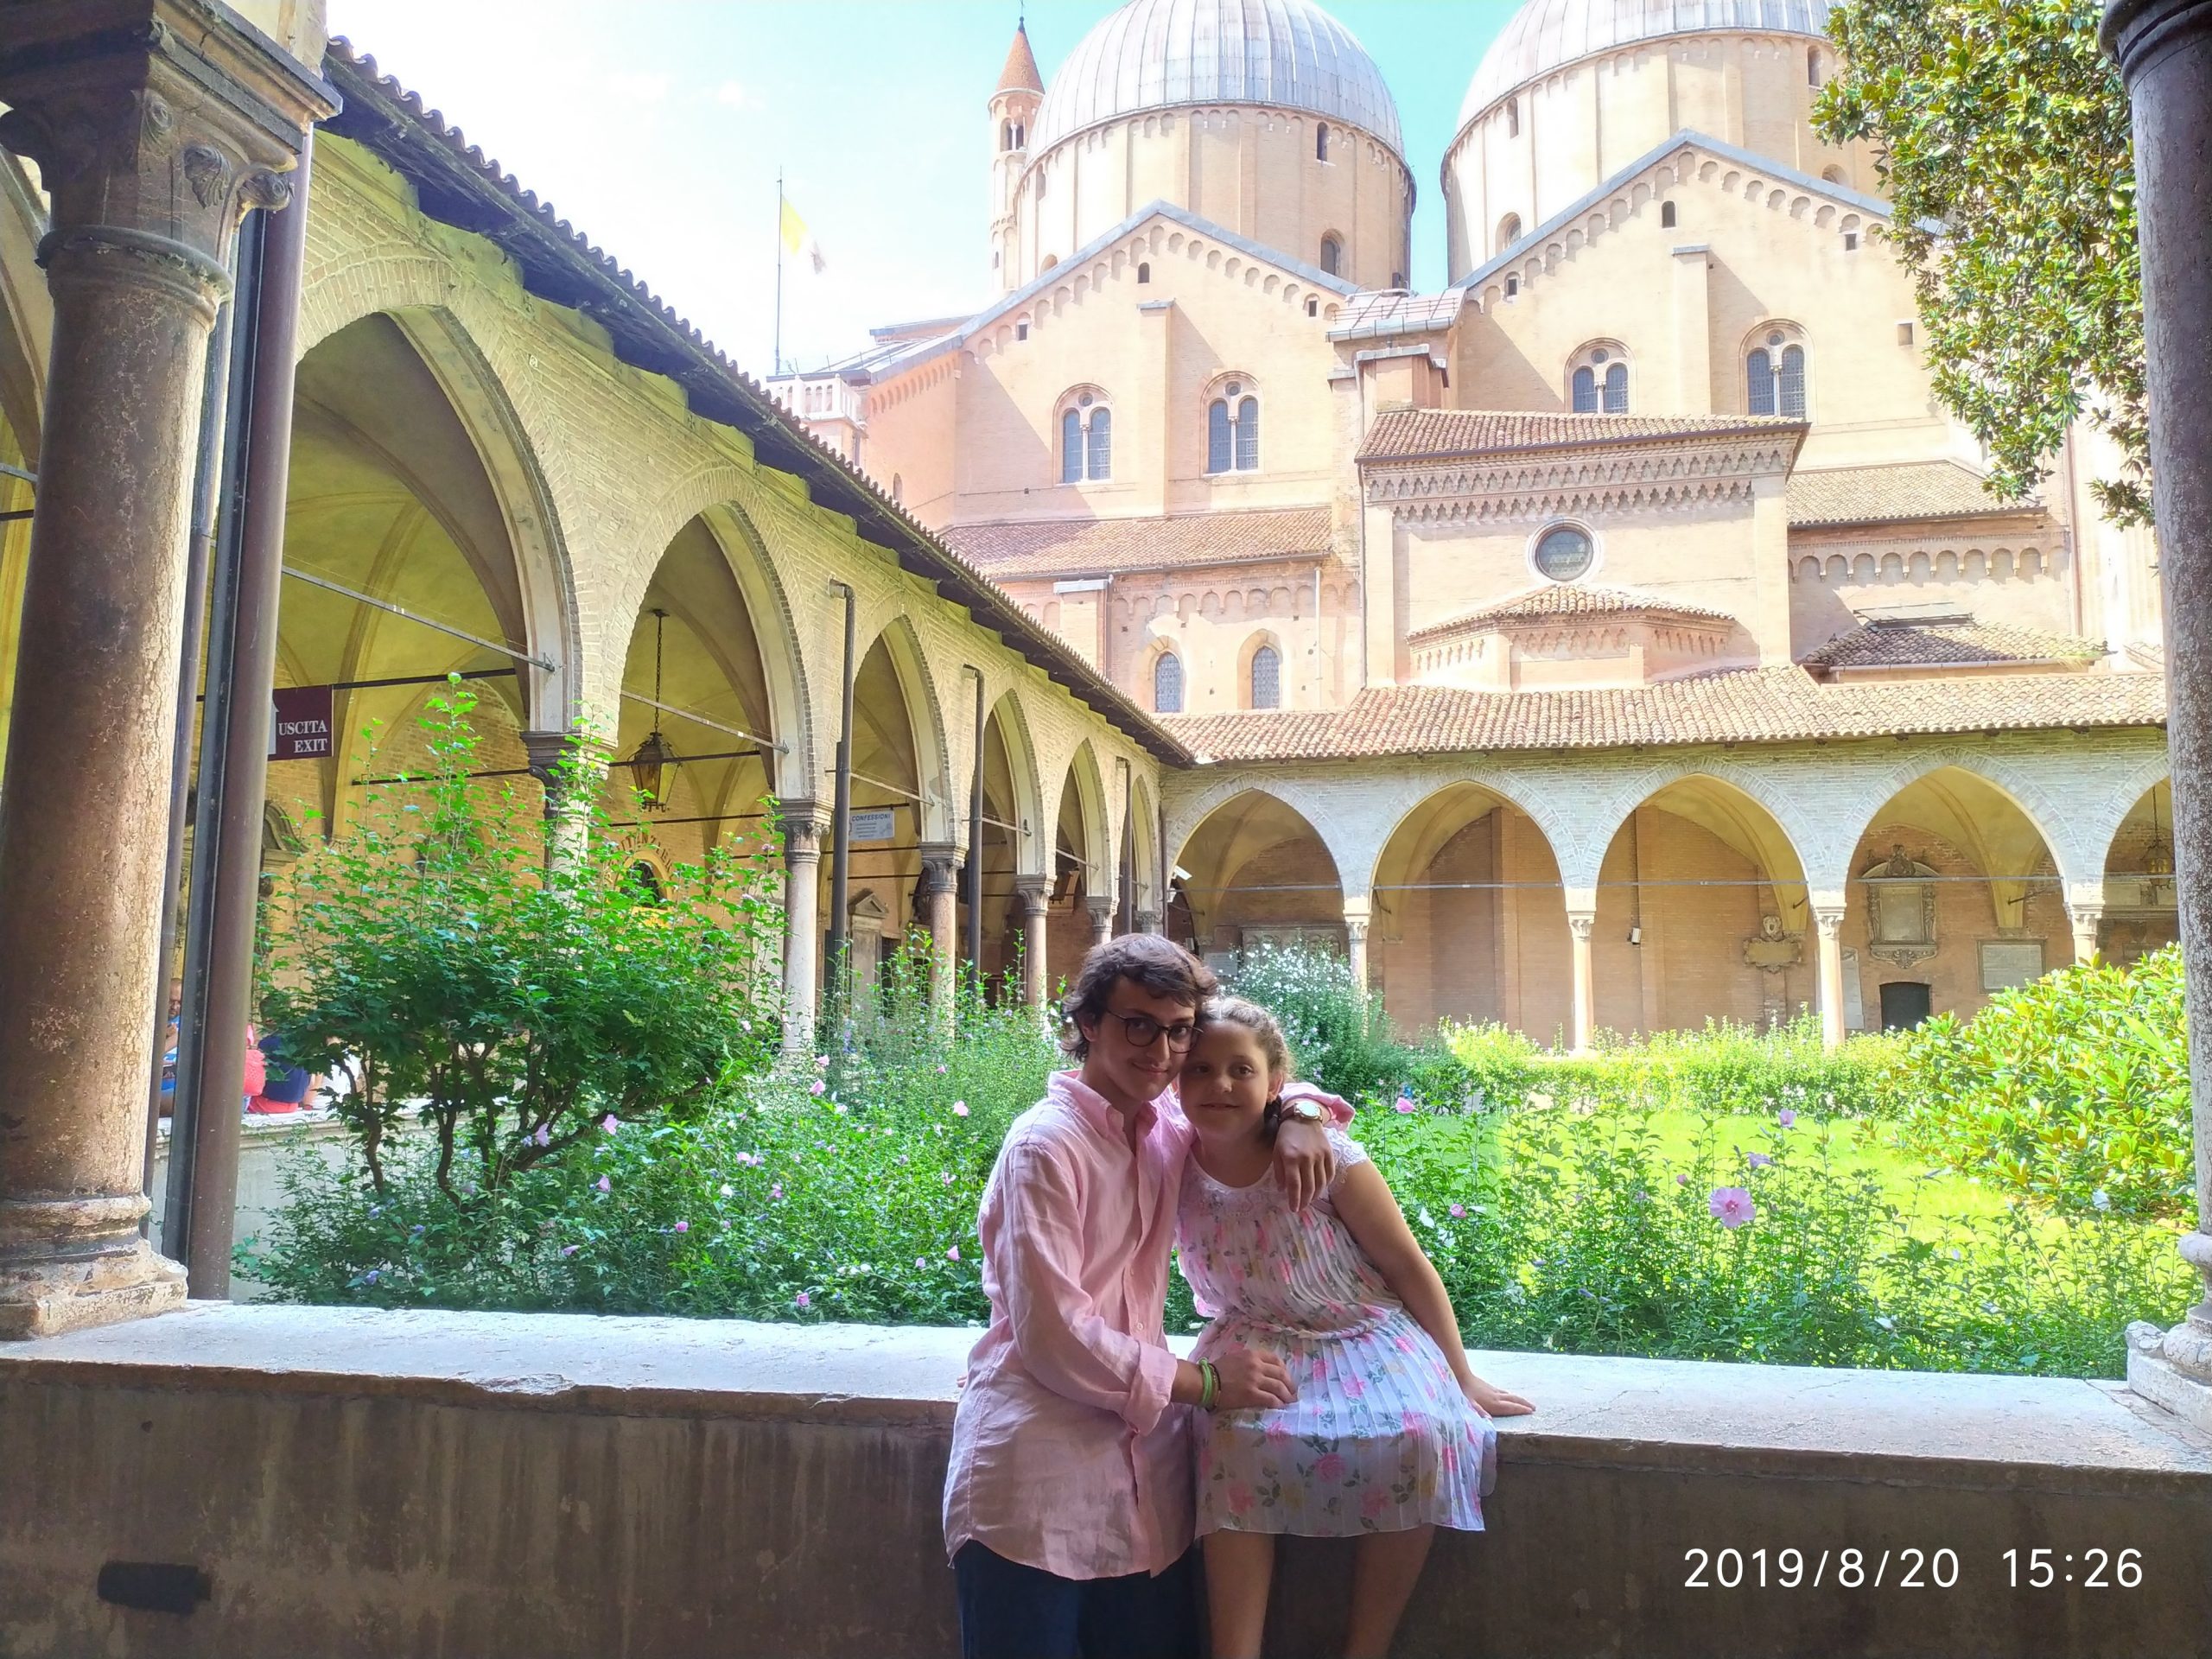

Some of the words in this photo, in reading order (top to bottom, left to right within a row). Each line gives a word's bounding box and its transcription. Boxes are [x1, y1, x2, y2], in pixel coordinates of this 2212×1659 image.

[277, 719, 328, 736] USCITA
[294, 738, 328, 753] EXIT
[851, 813, 891, 822] CONFESSIONI
